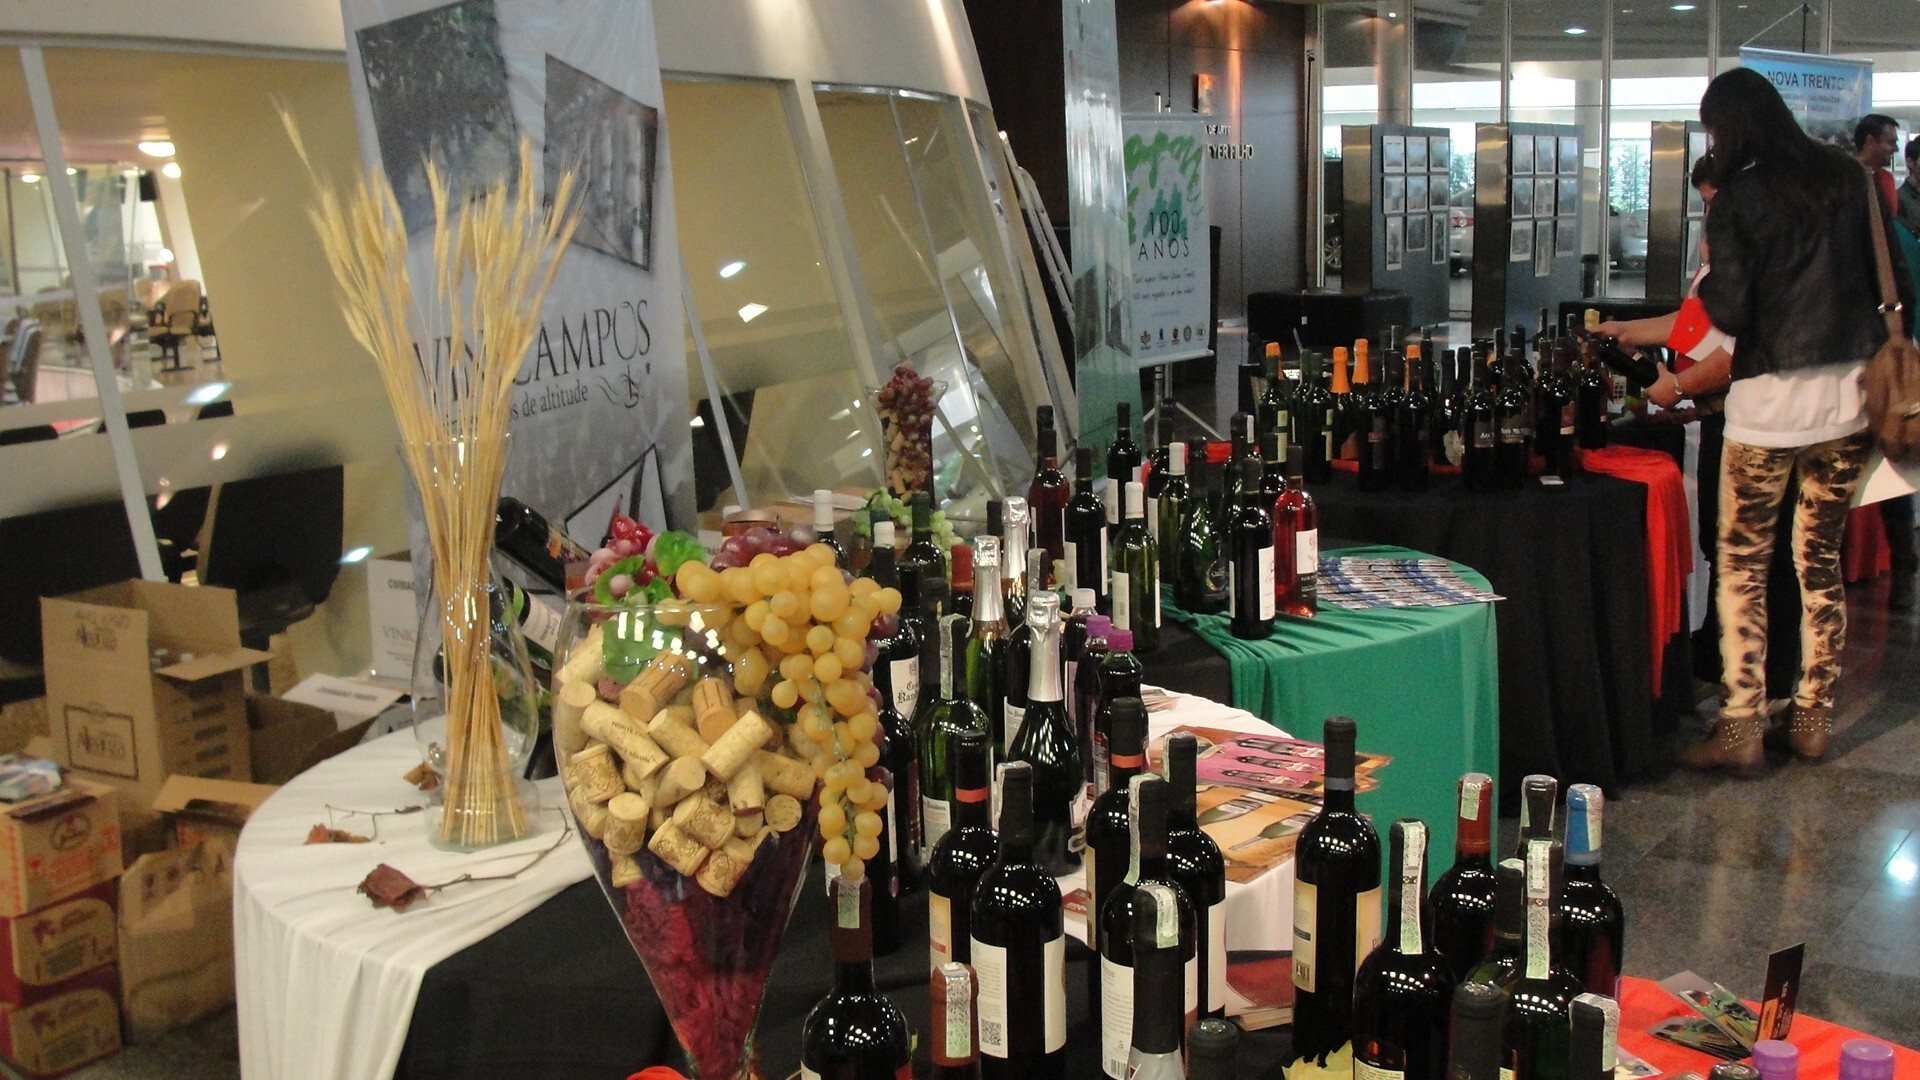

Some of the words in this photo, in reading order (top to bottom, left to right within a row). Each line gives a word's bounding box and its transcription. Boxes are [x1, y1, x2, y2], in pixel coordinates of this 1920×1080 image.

[1767, 71, 1799, 87] NOVA
[1802, 73, 1845, 91] TRENTO
[1150, 210, 1180, 236] 100
[1138, 237, 1190, 261] ANOS
[523, 391, 537, 417] de
[540, 379, 589, 413] altitude
